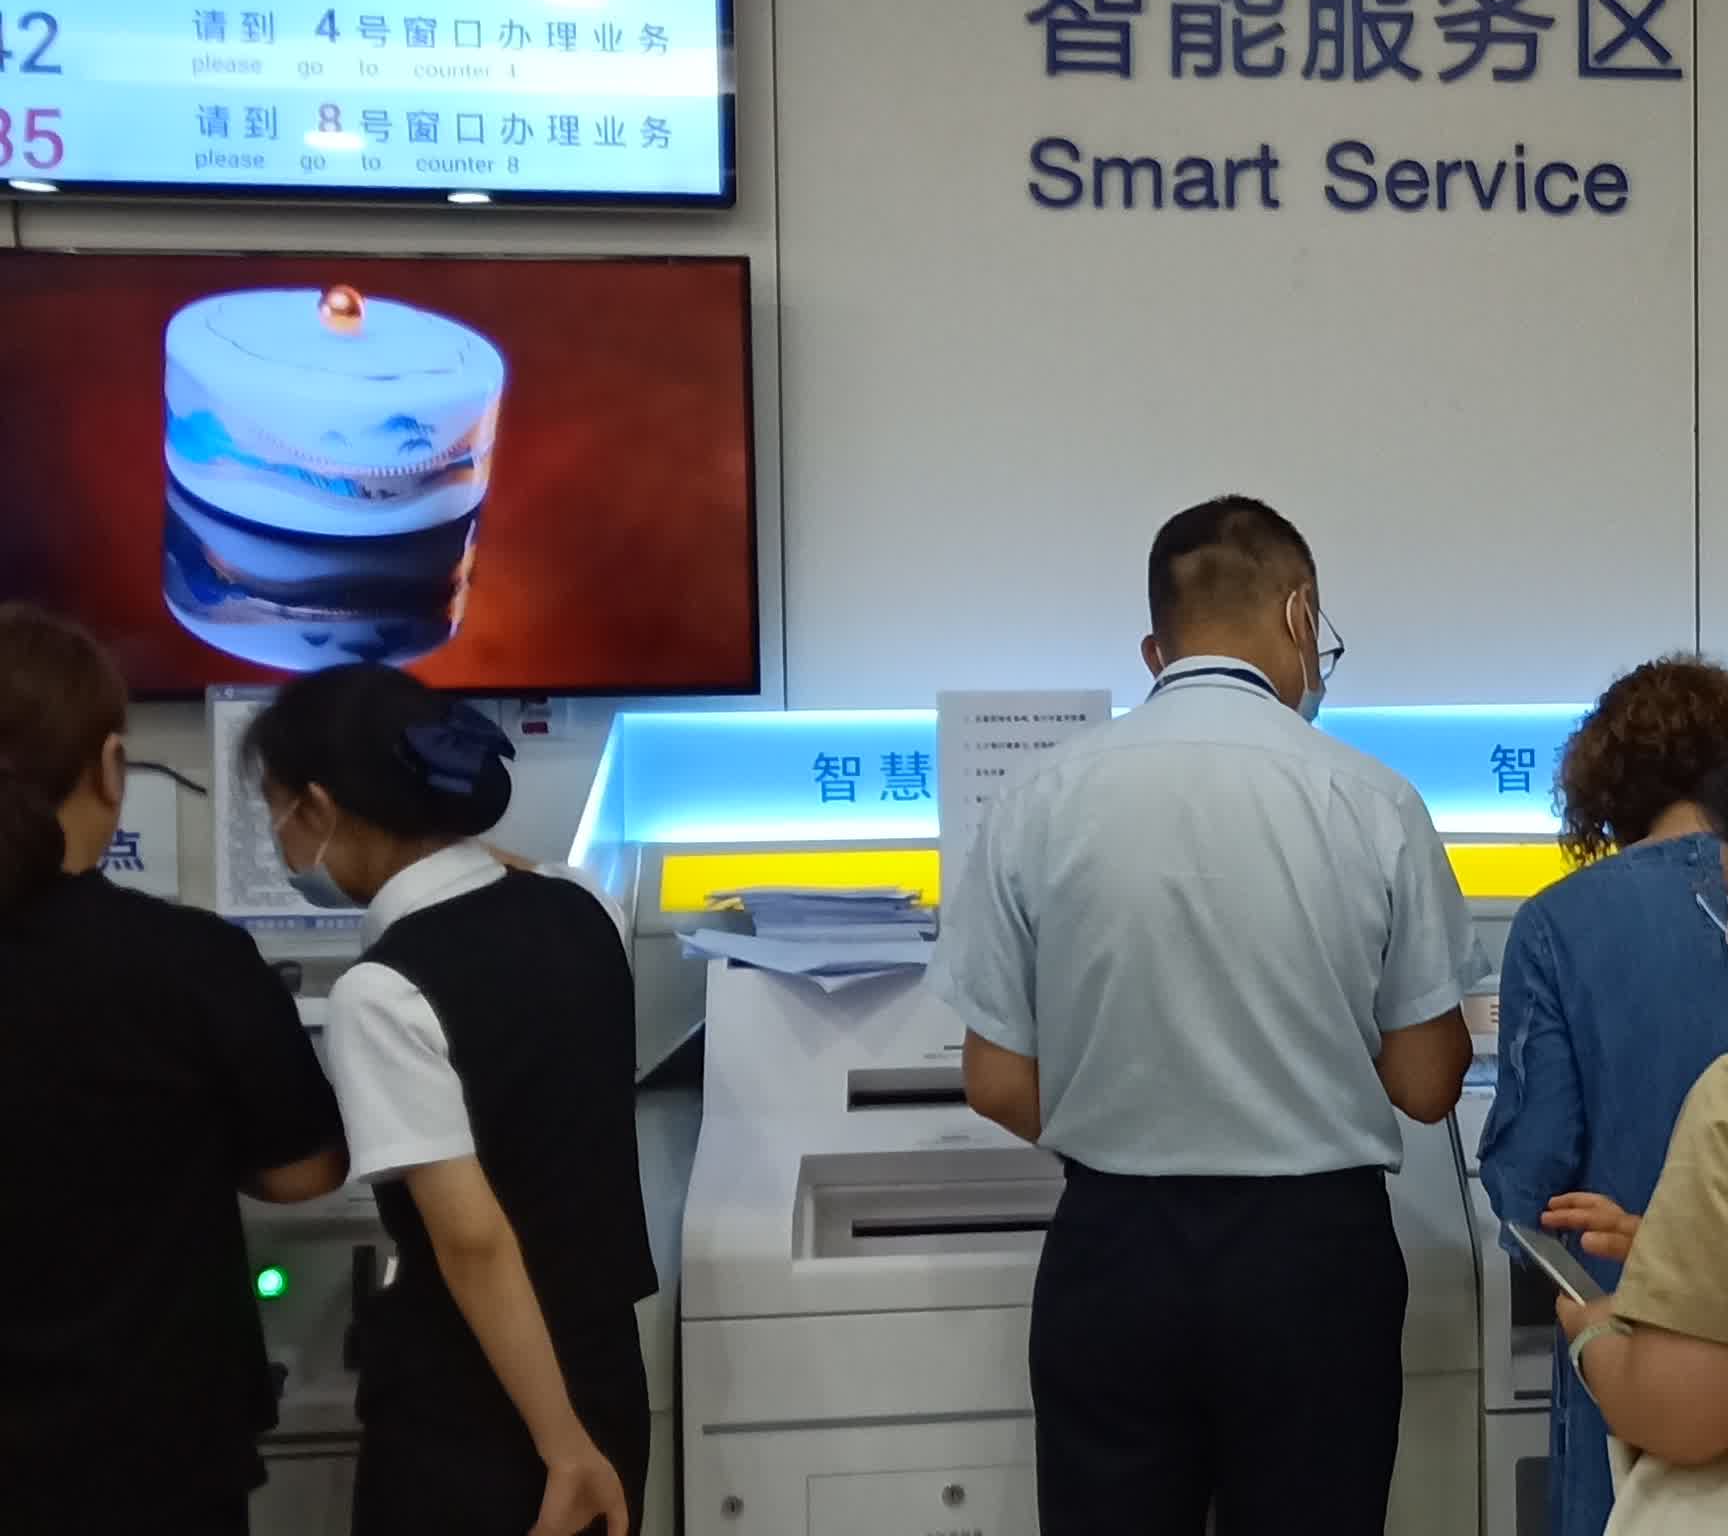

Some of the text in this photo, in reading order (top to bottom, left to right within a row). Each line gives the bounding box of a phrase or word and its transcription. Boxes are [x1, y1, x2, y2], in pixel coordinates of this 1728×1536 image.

[192, 54, 262, 76] please
[297, 61, 324, 77] go
[359, 60, 379, 76] to
[414, 62, 490, 80] counter
[195, 151, 519, 174] please go to counter 8
[1027, 137, 1630, 216] Smart Service
[812, 750, 932, 803] 智慧
[1490, 743, 1536, 794] 智
